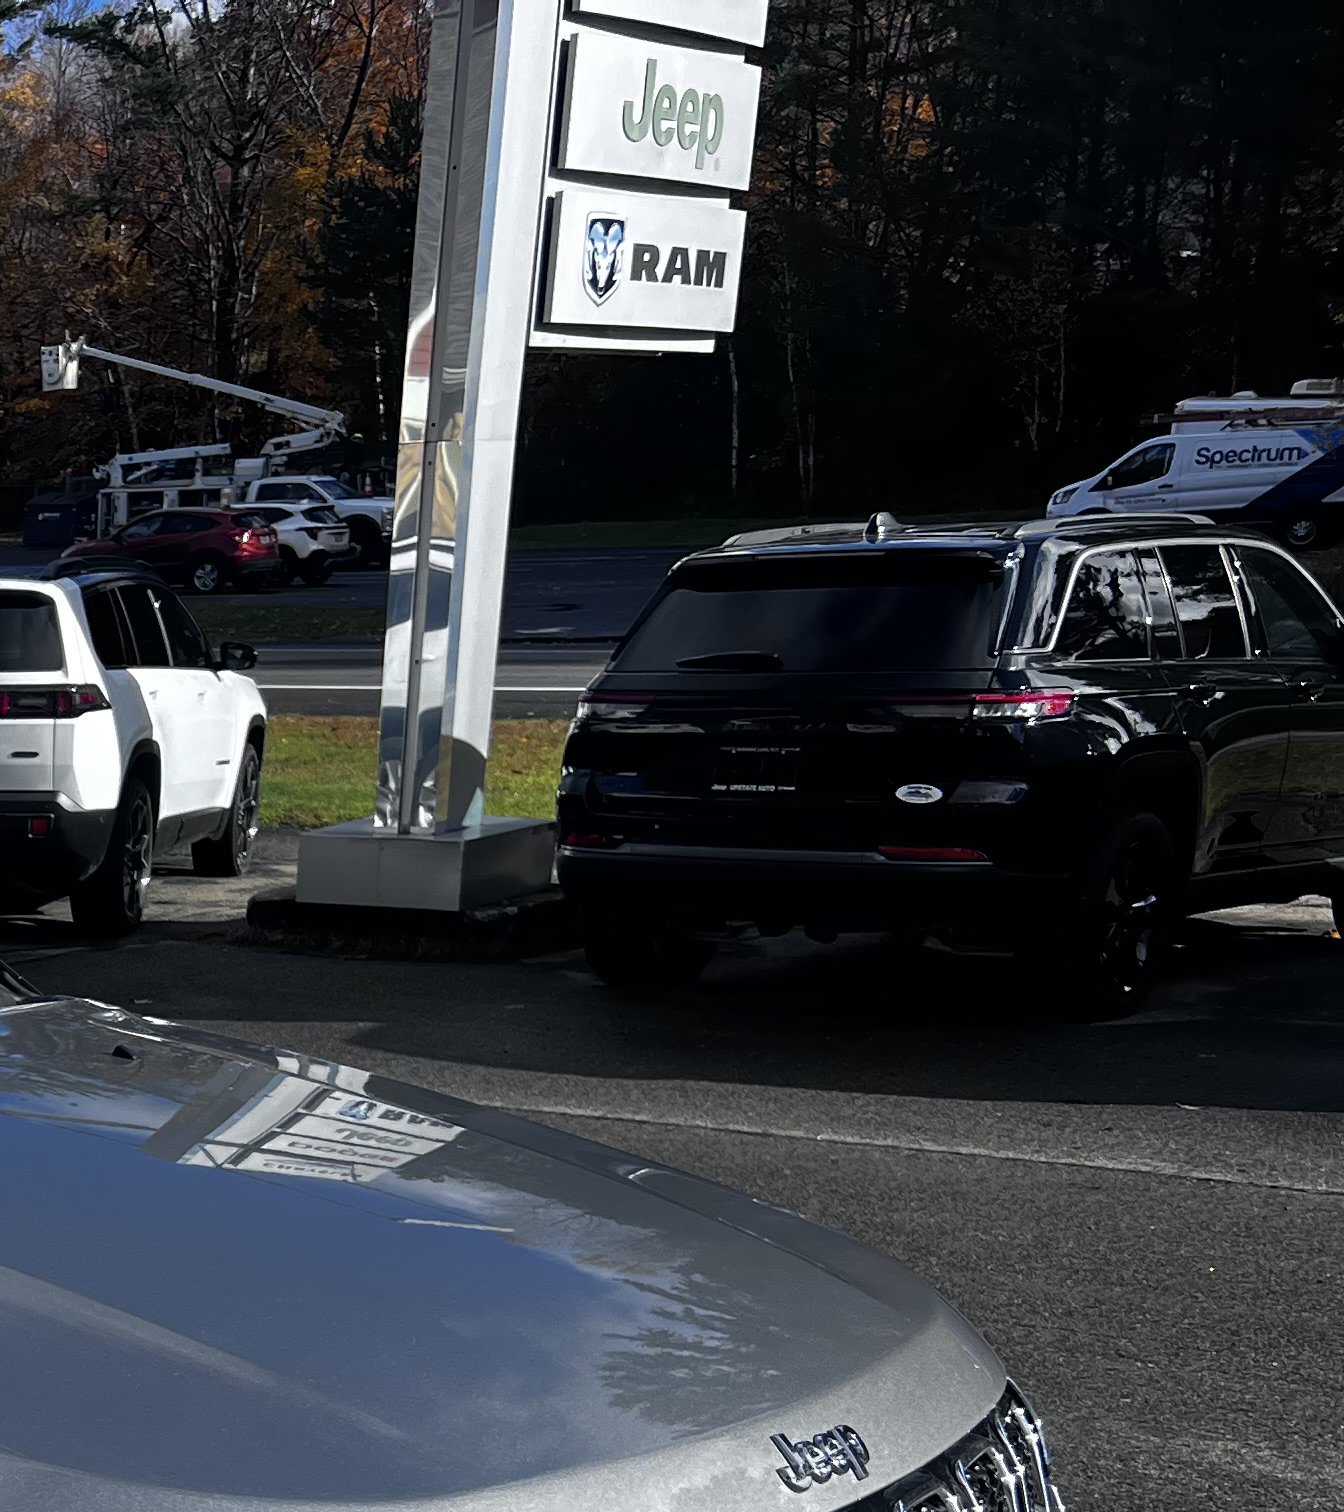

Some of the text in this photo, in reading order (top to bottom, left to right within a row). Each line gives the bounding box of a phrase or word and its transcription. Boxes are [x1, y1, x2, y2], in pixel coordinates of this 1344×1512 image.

[623, 58, 724, 169] Jeep
[630, 243, 727, 288] RAM
[1195, 445, 1302, 469] Spectrum
[769, 1424, 870, 1493] Jeep
